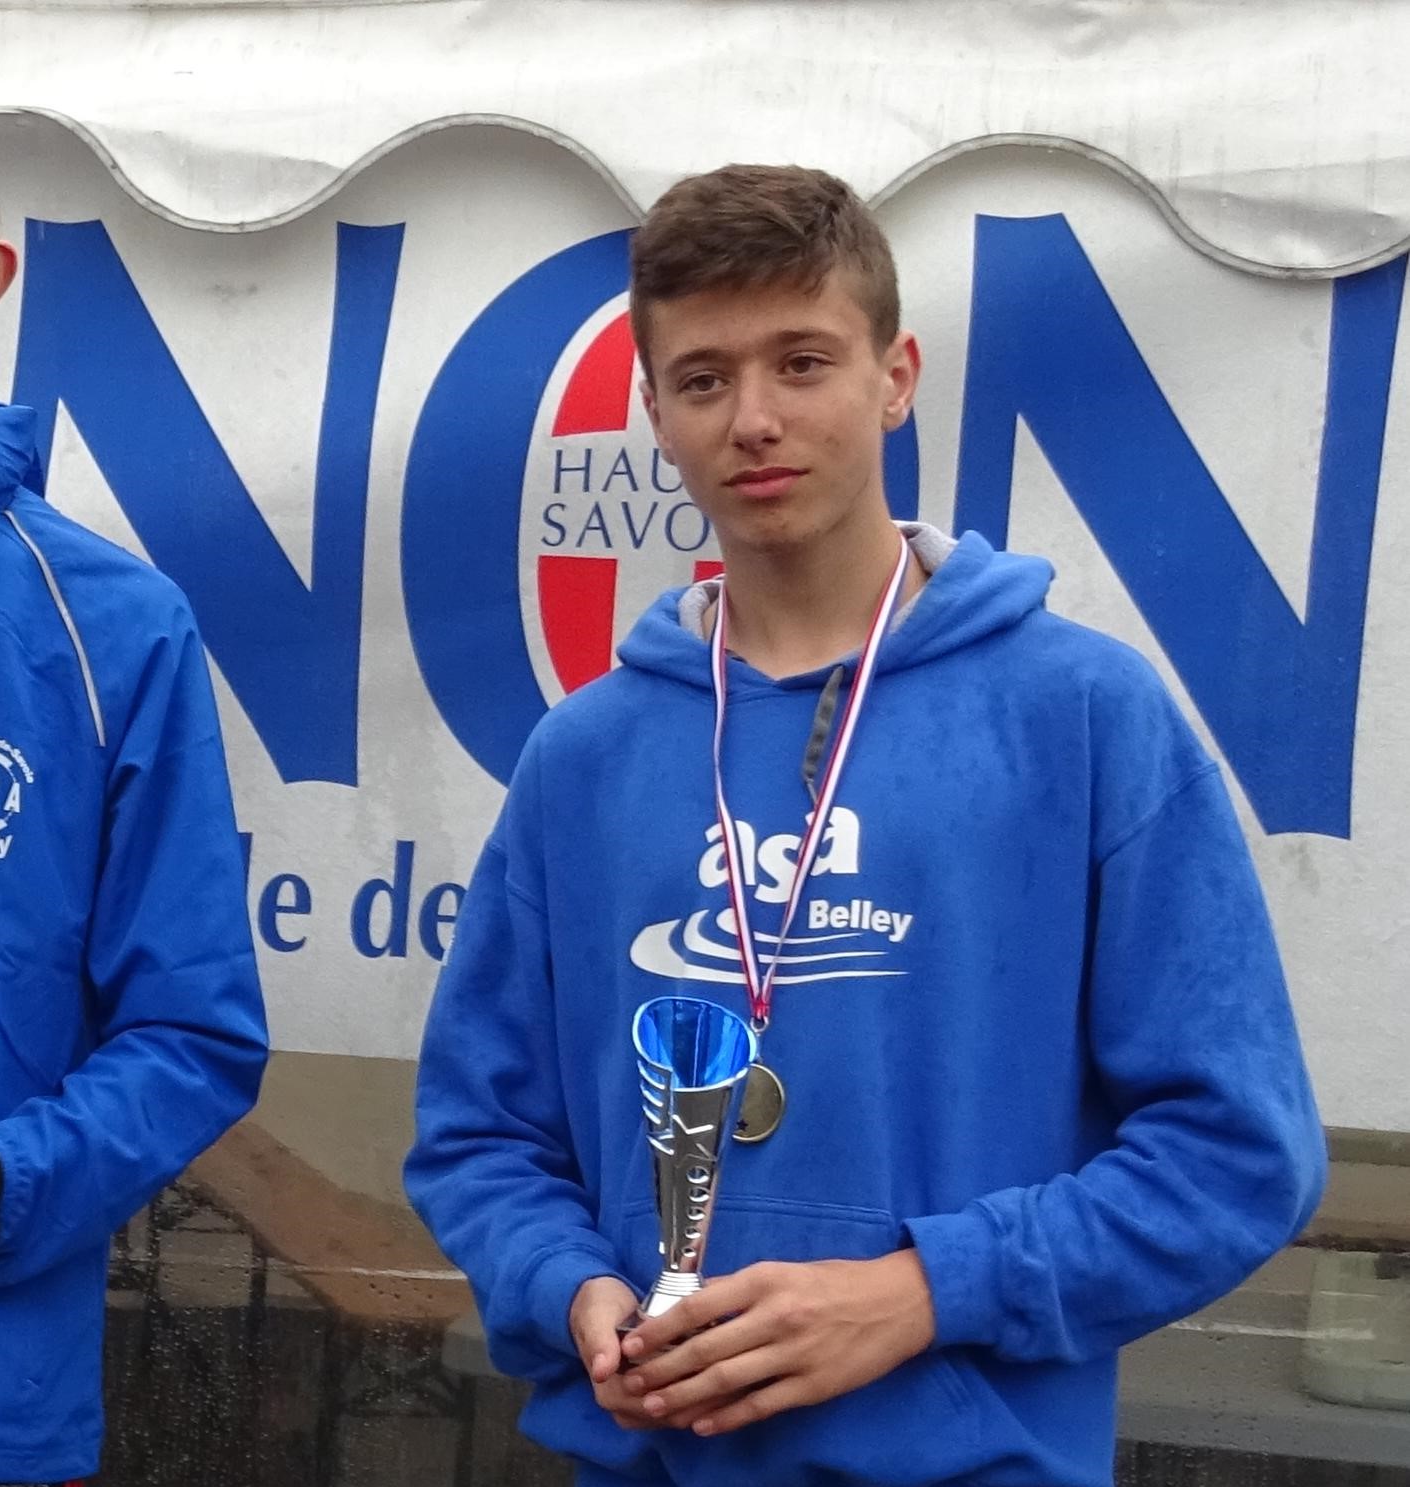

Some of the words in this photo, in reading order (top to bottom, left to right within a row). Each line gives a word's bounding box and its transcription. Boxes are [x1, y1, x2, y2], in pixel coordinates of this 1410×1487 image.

[553, 446, 683, 494] HAU
[541, 500, 711, 552] SAVO
[698, 806, 860, 904] asa
[808, 899, 914, 943] Belley
